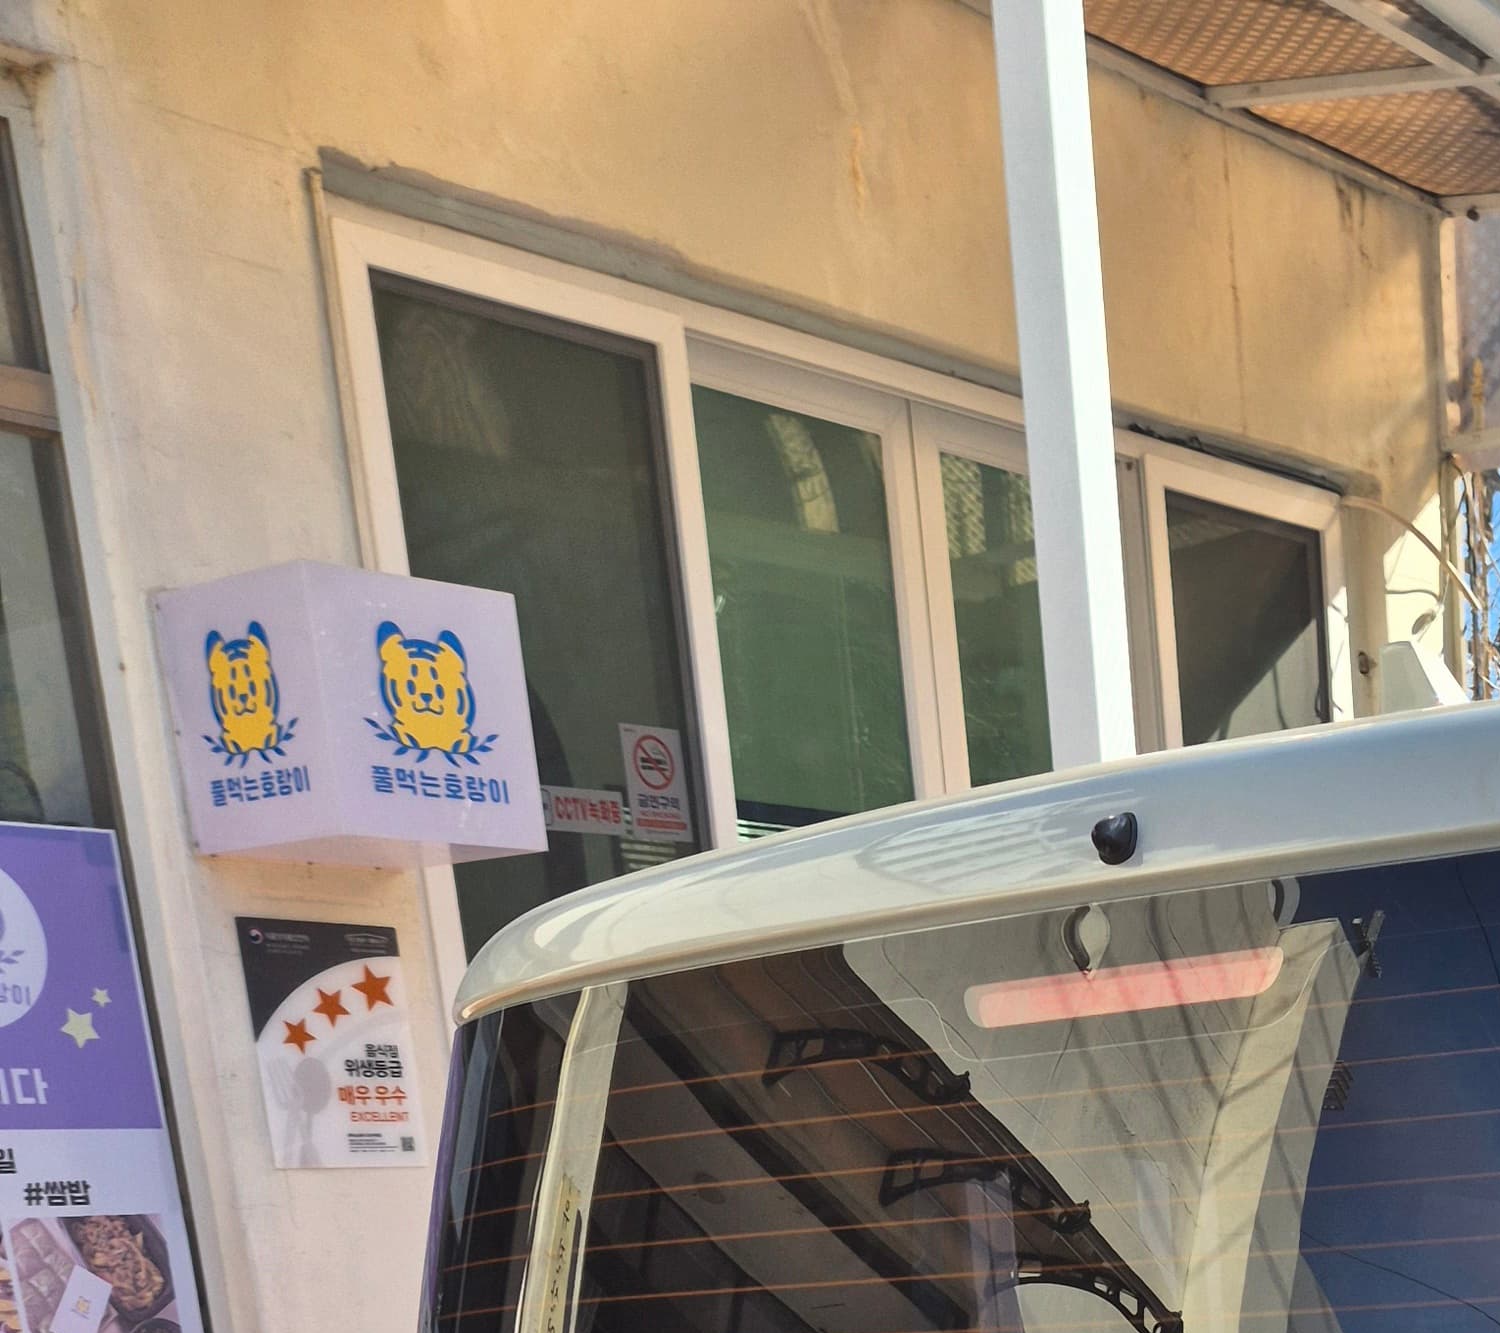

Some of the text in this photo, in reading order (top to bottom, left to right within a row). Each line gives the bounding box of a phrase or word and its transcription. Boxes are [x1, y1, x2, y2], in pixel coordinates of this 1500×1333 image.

[210, 765, 311, 807] 풀먹는호랑이
[371, 765, 510, 804] 풀먹는호랑이
[344, 1059, 403, 1078] 위생등급
[338, 1085, 407, 1106] 매우 우수
[351, 1111, 409, 1122] EXCELLENT
[24, 1180, 91, 1206] #쌈밥
